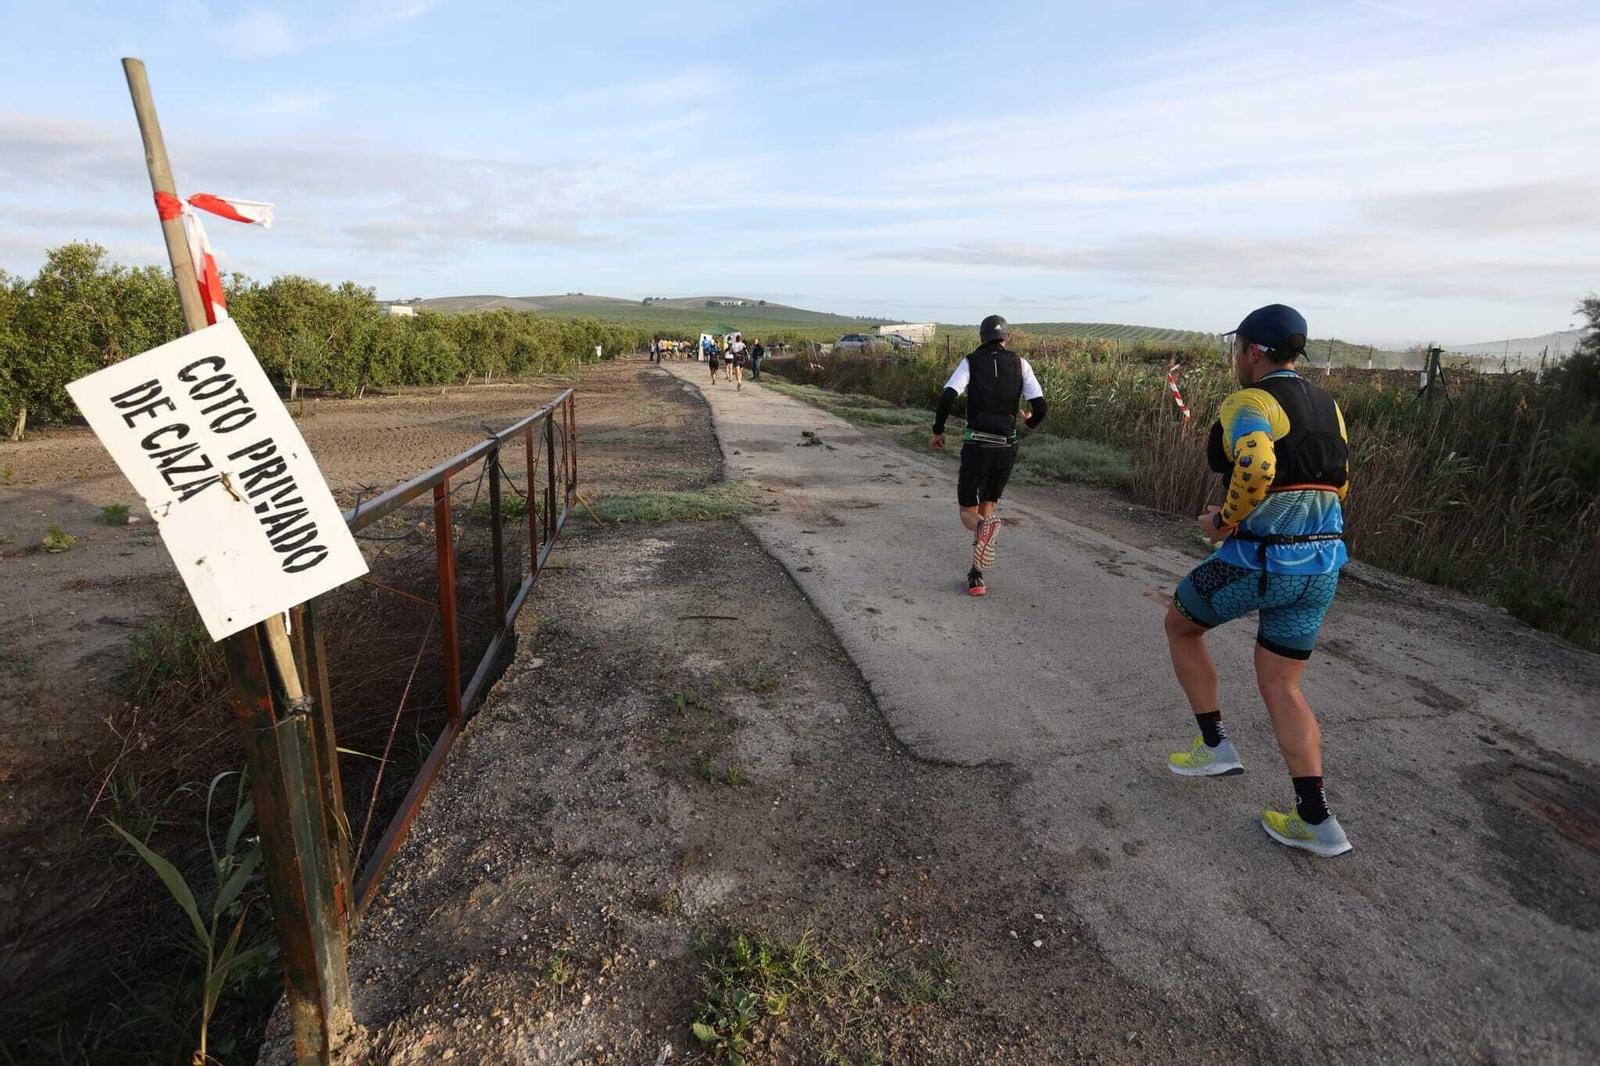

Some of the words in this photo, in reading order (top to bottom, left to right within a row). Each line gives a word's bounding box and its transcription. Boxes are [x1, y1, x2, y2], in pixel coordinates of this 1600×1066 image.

[110, 378, 177, 429] DE
[140, 422, 222, 503] CAZA
[177, 355, 257, 433] COTO
[227, 437, 329, 574] PRIVADO
